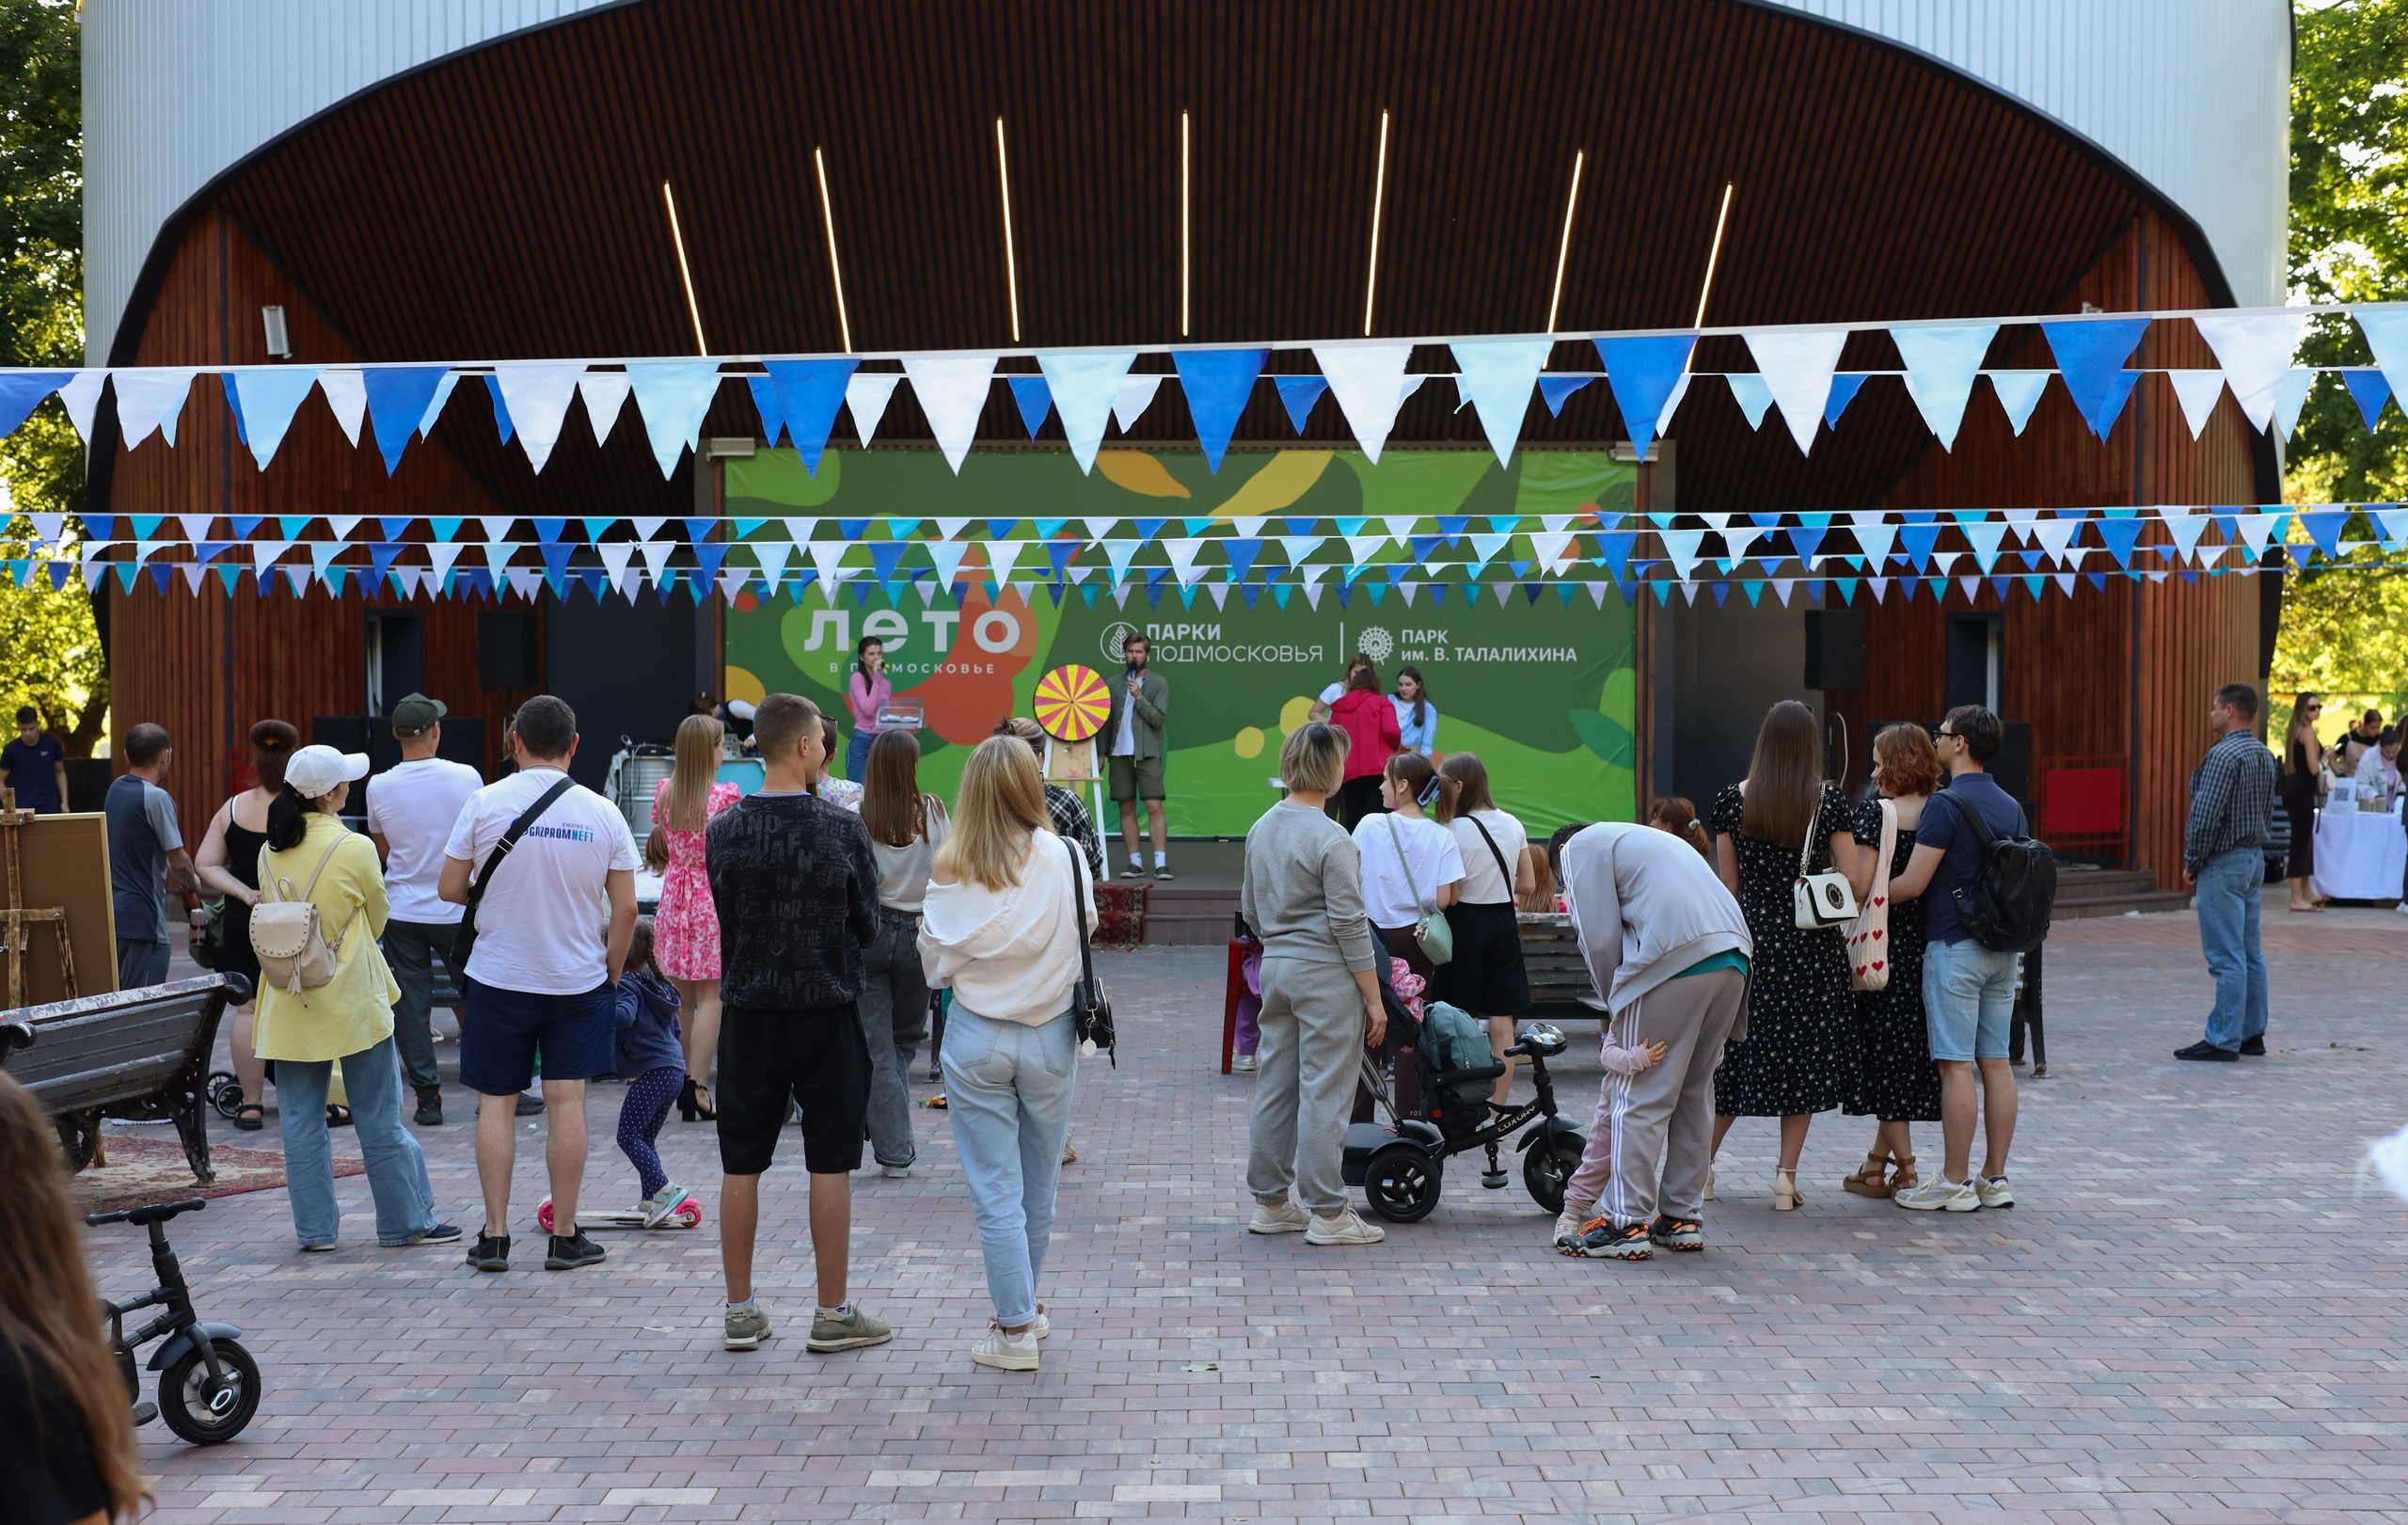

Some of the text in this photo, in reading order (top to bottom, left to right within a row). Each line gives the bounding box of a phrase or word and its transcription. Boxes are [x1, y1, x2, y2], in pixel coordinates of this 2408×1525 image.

[1147, 624, 1221, 641] ПАРКИ
[1402, 629, 1449, 643] ПАРК
[1147, 645, 1323, 662] ПОДМОСКОВЬЯ
[1402, 647, 1577, 662] им. В. ТАЛАЛИХИНА
[830, 662, 995, 675] В ПМОСКОВЬЕ
[529, 826, 594, 843] GAZPROMNEFT
